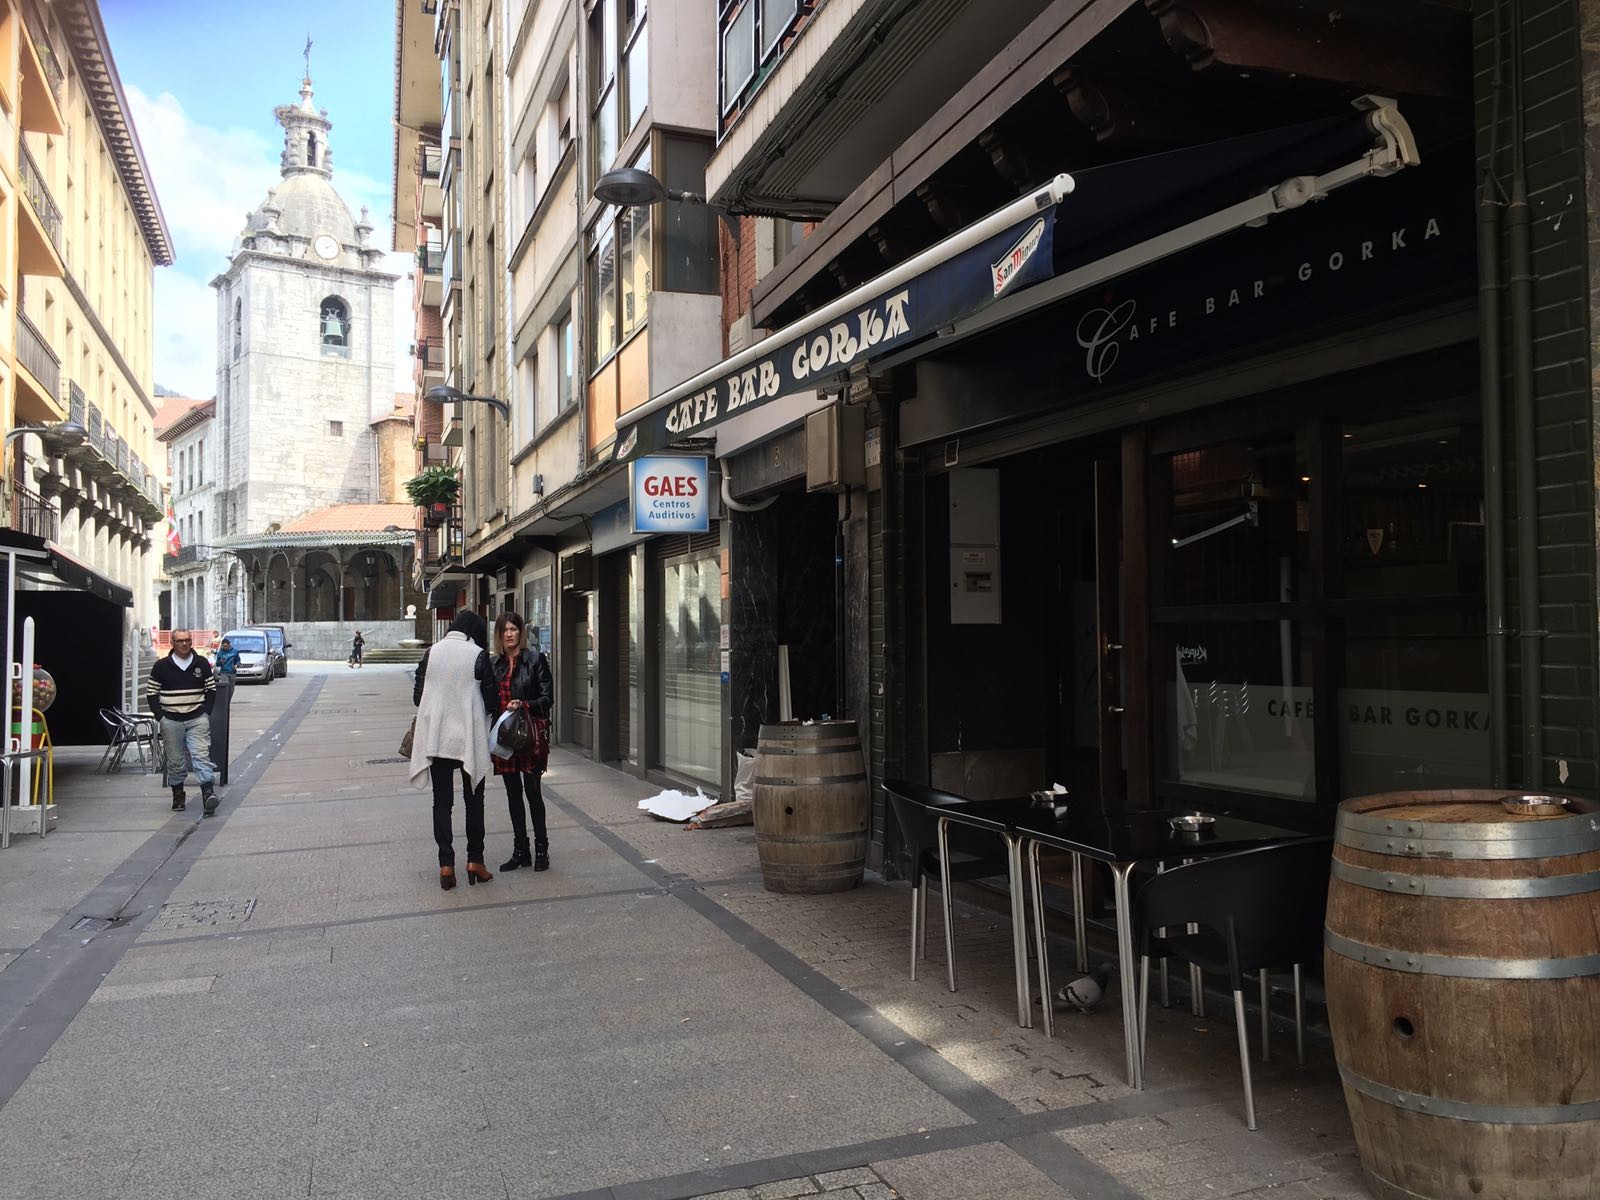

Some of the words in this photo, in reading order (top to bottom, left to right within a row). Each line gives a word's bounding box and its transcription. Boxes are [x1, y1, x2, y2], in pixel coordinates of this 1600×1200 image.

[1076, 299, 1177, 384] CAFE
[1205, 280, 1265, 315] BAR
[1297, 217, 1441, 281] GORKA
[665, 387, 719, 434] CAFE
[727, 360, 780, 412] BAR
[792, 290, 911, 381] GORKA
[644, 476, 698, 497] GAES
[653, 499, 691, 509] Centros
[648, 510, 696, 520] Auditivos
[1349, 705, 1393, 726] BAR
